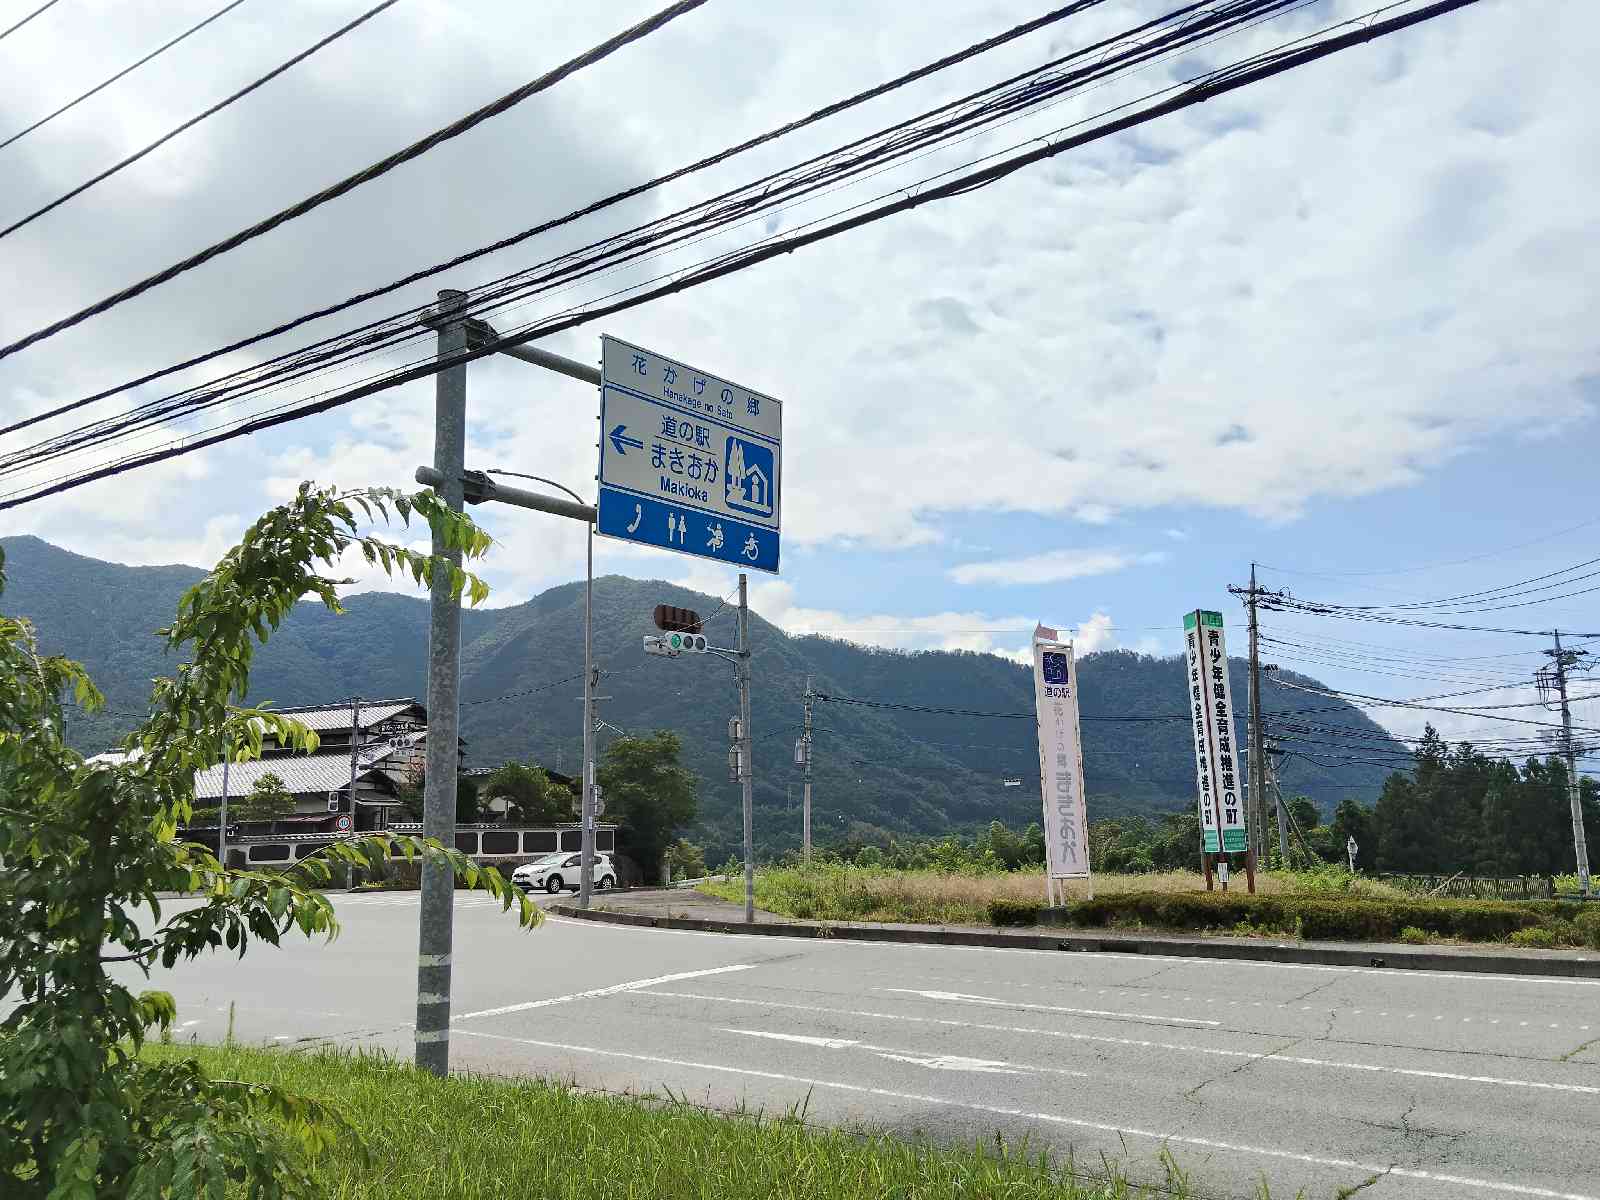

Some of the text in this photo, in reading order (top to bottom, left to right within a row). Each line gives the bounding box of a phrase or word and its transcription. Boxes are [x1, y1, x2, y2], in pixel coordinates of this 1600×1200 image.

[632, 354, 760, 416] 花かげの郷
[663, 386, 733, 419] Hanakage no Sato
[661, 415, 710, 448] 道の駅
[651, 443, 719, 483] まきおか
[661, 476, 708, 502] Makioka
[1045, 686, 1071, 698] 道の駅
[1207, 629, 1237, 824] 青少年健全育成推進の町
